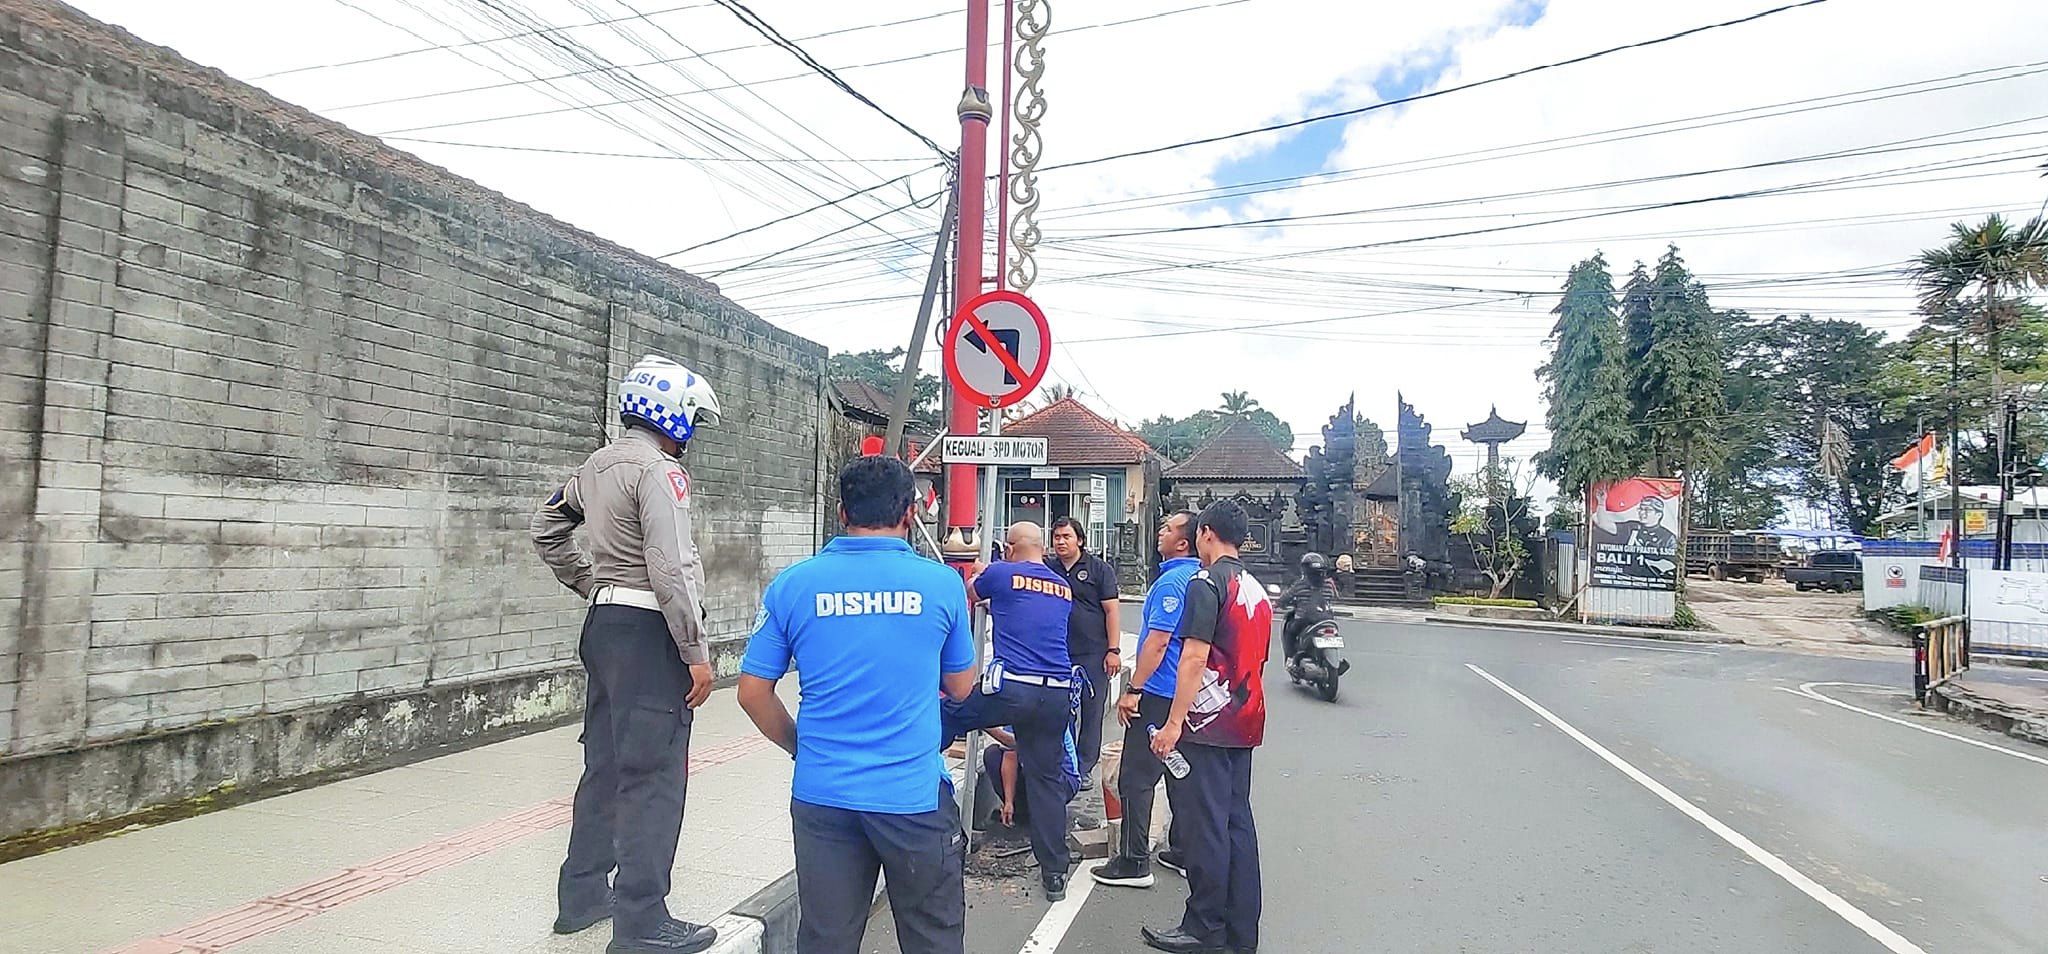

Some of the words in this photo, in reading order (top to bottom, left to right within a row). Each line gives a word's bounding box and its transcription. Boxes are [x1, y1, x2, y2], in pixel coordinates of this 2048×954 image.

[1012, 441, 1044, 459] MOTOR
[1597, 552, 1631, 565] BALI
[1637, 555, 1644, 566] 1
[815, 590, 923, 617] DISHUB
